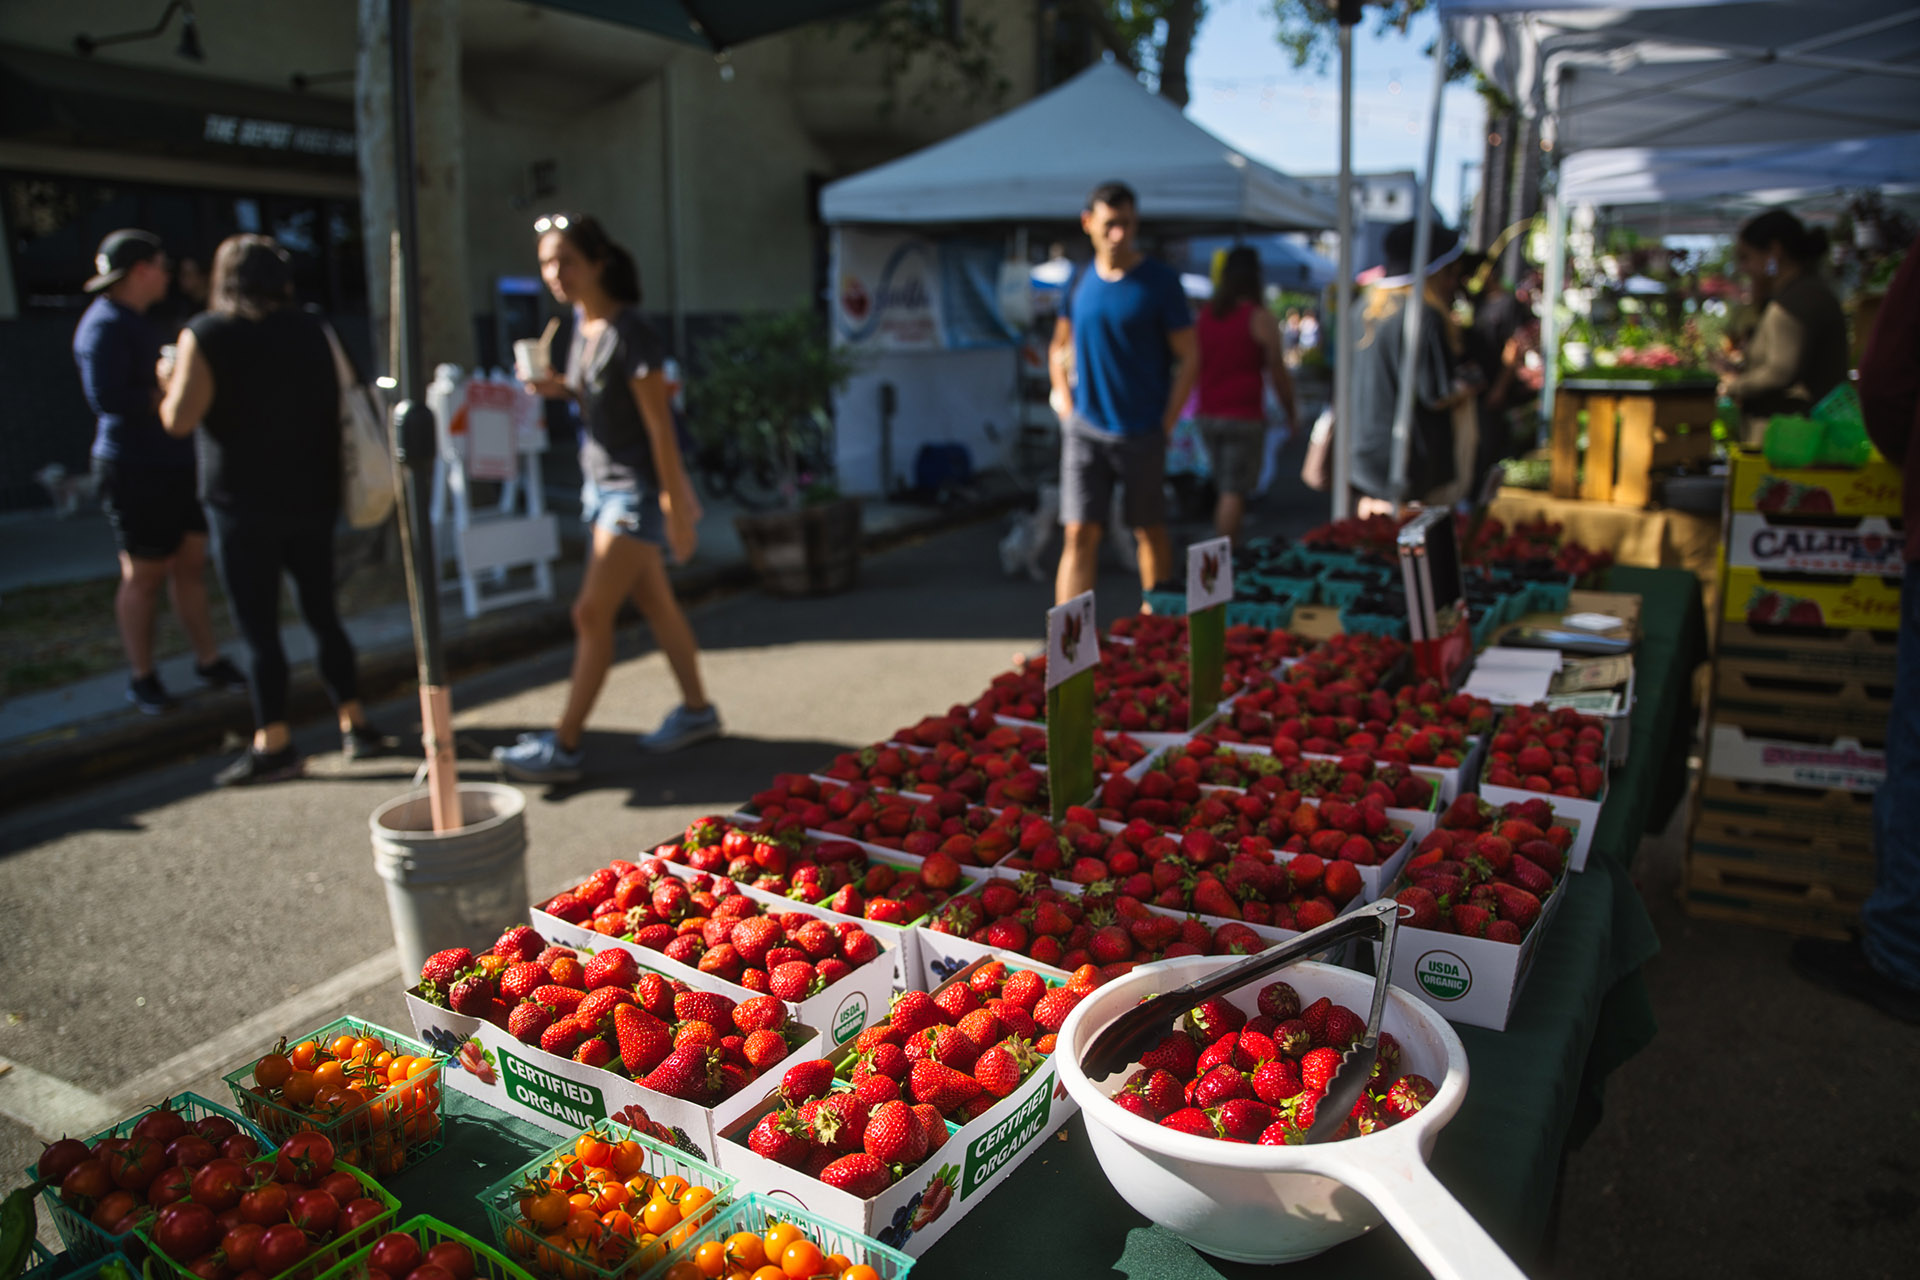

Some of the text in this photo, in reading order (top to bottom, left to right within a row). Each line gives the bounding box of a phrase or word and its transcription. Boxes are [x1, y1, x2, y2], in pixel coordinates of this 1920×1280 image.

[1428, 960, 1459, 976] USDA
[1424, 974, 1463, 990] ORGANIC
[840, 1002, 860, 1023] USDA
[837, 1014, 863, 1038] ORGANIC
[506, 1055, 594, 1105] CERTIFIED
[975, 1082, 1048, 1158] CERTIFIED
[973, 1112, 1043, 1185] ORGANIC
